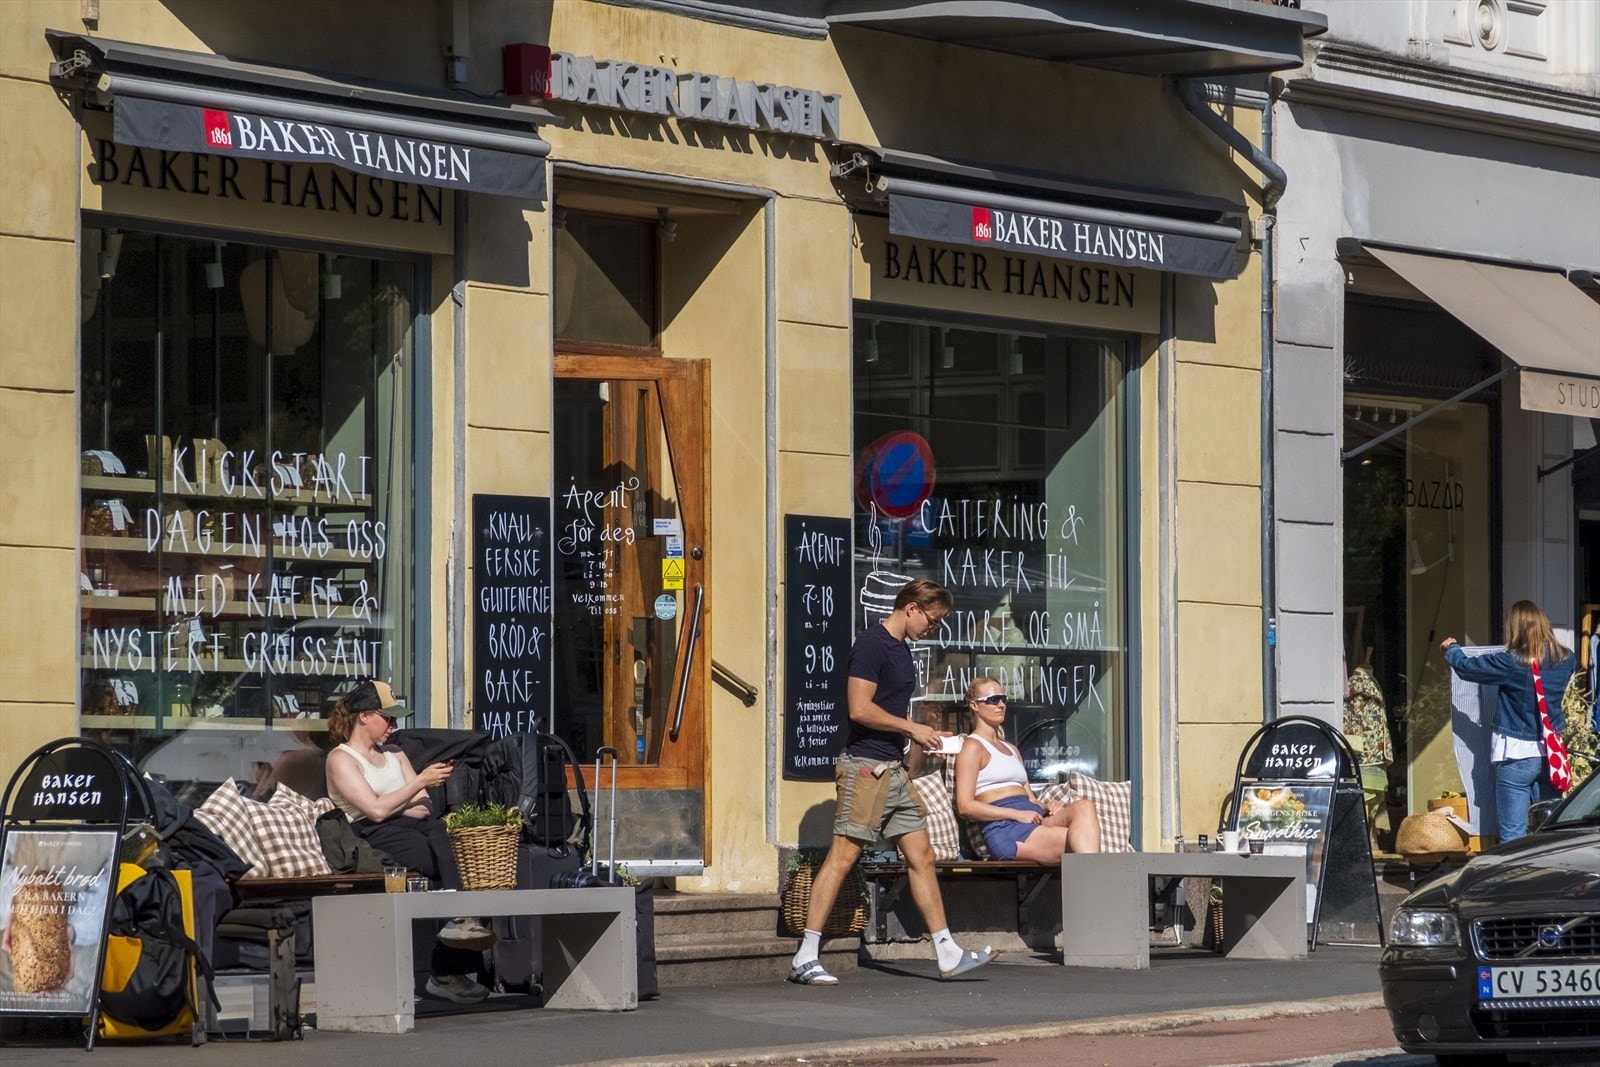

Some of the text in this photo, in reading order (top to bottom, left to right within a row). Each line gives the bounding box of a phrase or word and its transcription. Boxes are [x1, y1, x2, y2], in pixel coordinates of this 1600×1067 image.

[529, 51, 841, 145] 1861 BAKER HANSEN
[210, 115, 471, 183] 1861 BAKER HANSEN
[95, 139, 443, 226] BAKER HANSEN
[975, 211, 1164, 264] 1861 BAKER HANSEN
[884, 241, 1136, 309] BAKER HANSEN
[1558, 381, 1600, 409] STUD
[562, 476, 640, 526] Åpent
[147, 509, 260, 558] DAGEN
[280, 514, 329, 559] HOS
[347, 519, 386, 559] OSS
[489, 511, 540, 543] KNALL-
[600, 523, 635, 545] deg
[920, 496, 1085, 545] CATERING &
[485, 548, 540, 577] FERSKE
[798, 522, 845, 570] ÅPENT
[944, 548, 1076, 593] KAKER TIL
[165, 573, 378, 624] MED KAFFE &
[480, 580, 551, 614] GLUTENFRIE
[572, 594, 625, 607] Velkommen
[938, 600, 1103, 653] STORE OG SMÅ
[527, 626, 545, 661] &
[485, 668, 541, 704] BAKE-
[796, 697, 835, 714] Åpningstider
[482, 710, 541, 741] VARER
[796, 724, 839, 739] på helligdager
[798, 735, 828, 749] & ferier
[794, 754, 830, 769] Velkommen
[1291, 809, 1318, 817] FRISKE
[1245, 820, 1321, 840] Smoothies
[3, 864, 105, 897] Nybakt brød
[19, 891, 87, 902] FRA BAKERN
[1497, 970, 1524, 994] CV
